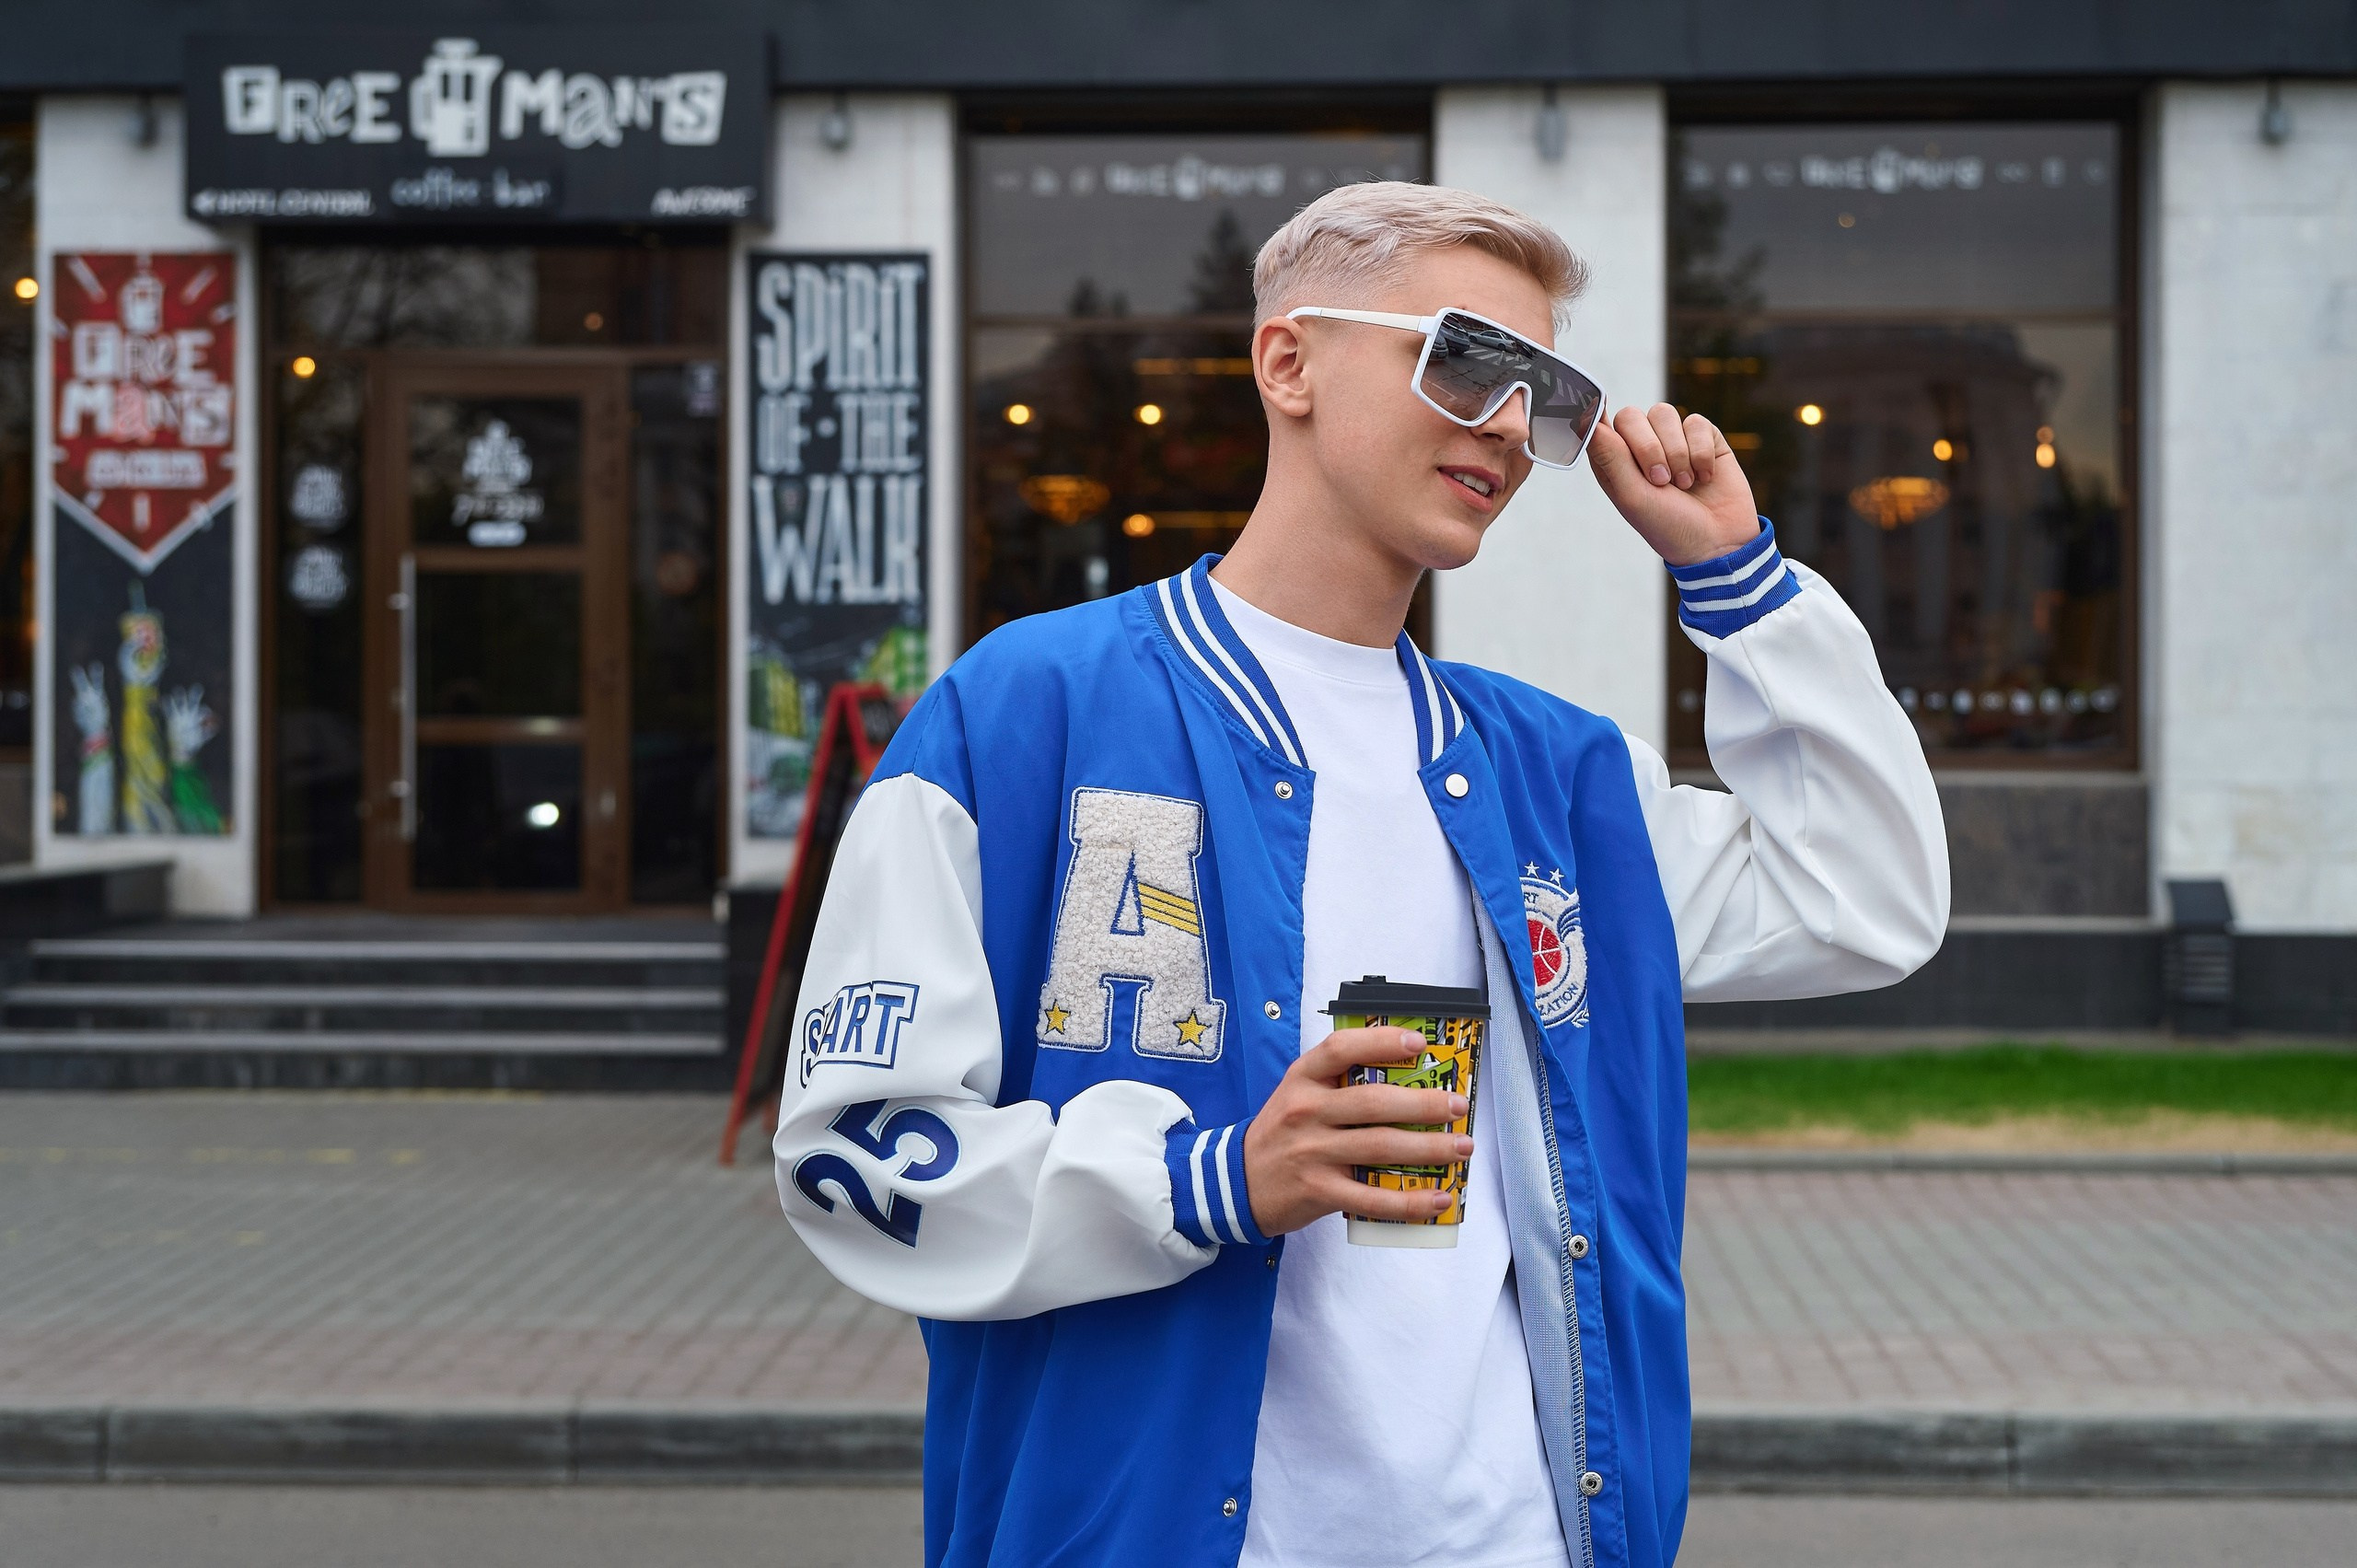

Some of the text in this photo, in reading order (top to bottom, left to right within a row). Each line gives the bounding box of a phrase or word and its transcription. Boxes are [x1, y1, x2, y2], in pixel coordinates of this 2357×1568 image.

[390, 166, 552, 210] coffee bar
[757, 391, 922, 475] OF THE
[752, 473, 923, 605] WALK
[1037, 786, 1227, 1063] A
[1538, 982, 1579, 1016] ZATION
[793, 1098, 961, 1250] 25
